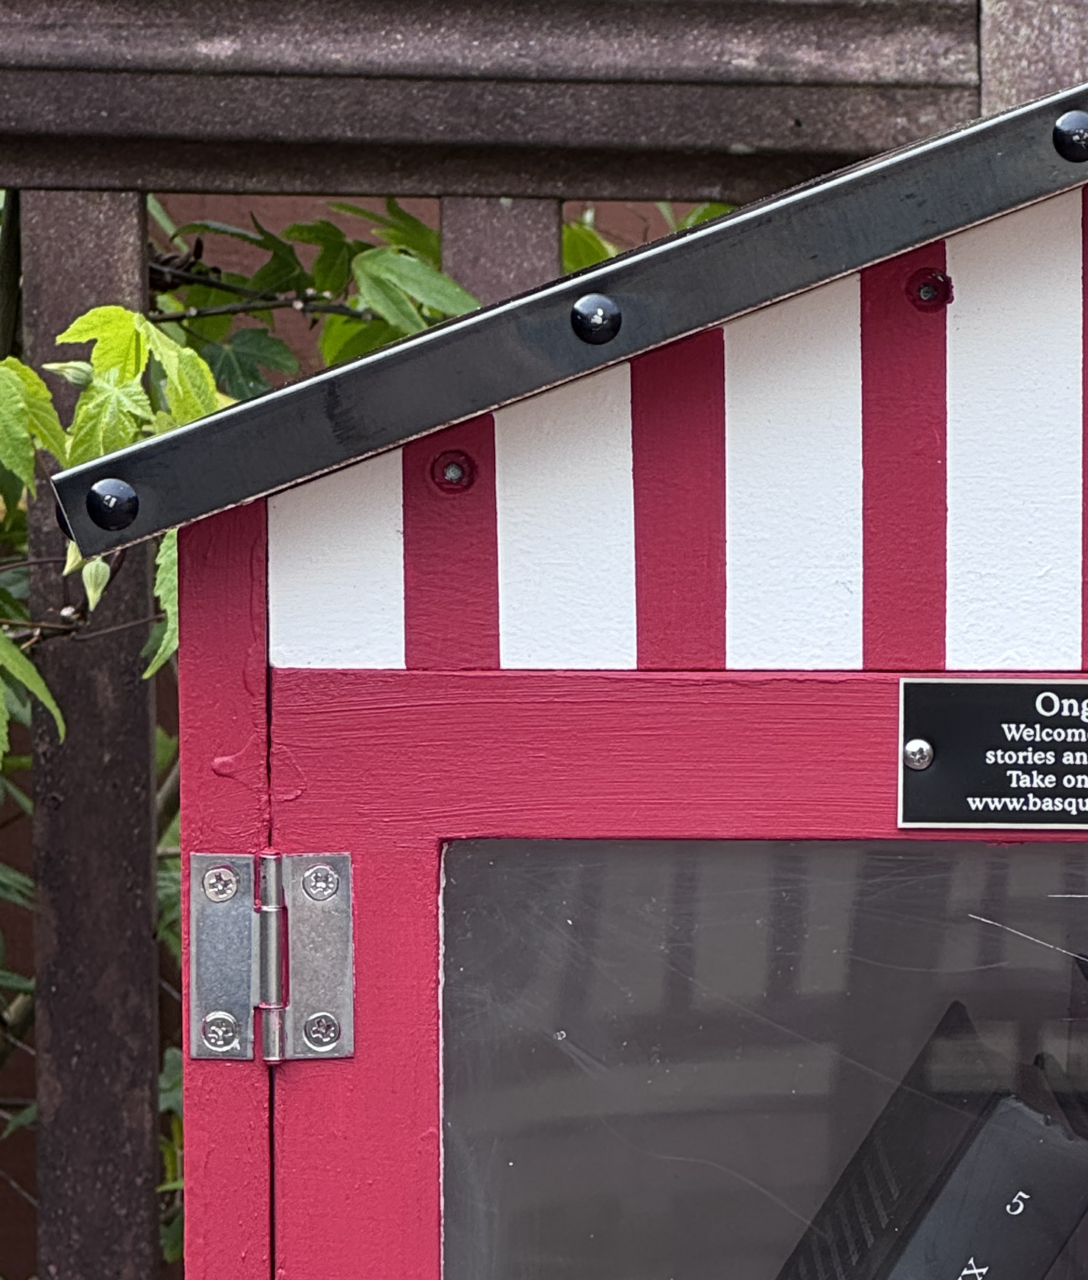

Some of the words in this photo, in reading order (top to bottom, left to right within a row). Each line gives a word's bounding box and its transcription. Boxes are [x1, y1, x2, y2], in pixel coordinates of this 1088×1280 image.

[985, 748, 1055, 765] stories
[1006, 771, 1056, 789] Take
[1006, 1191, 1031, 1215] 5
